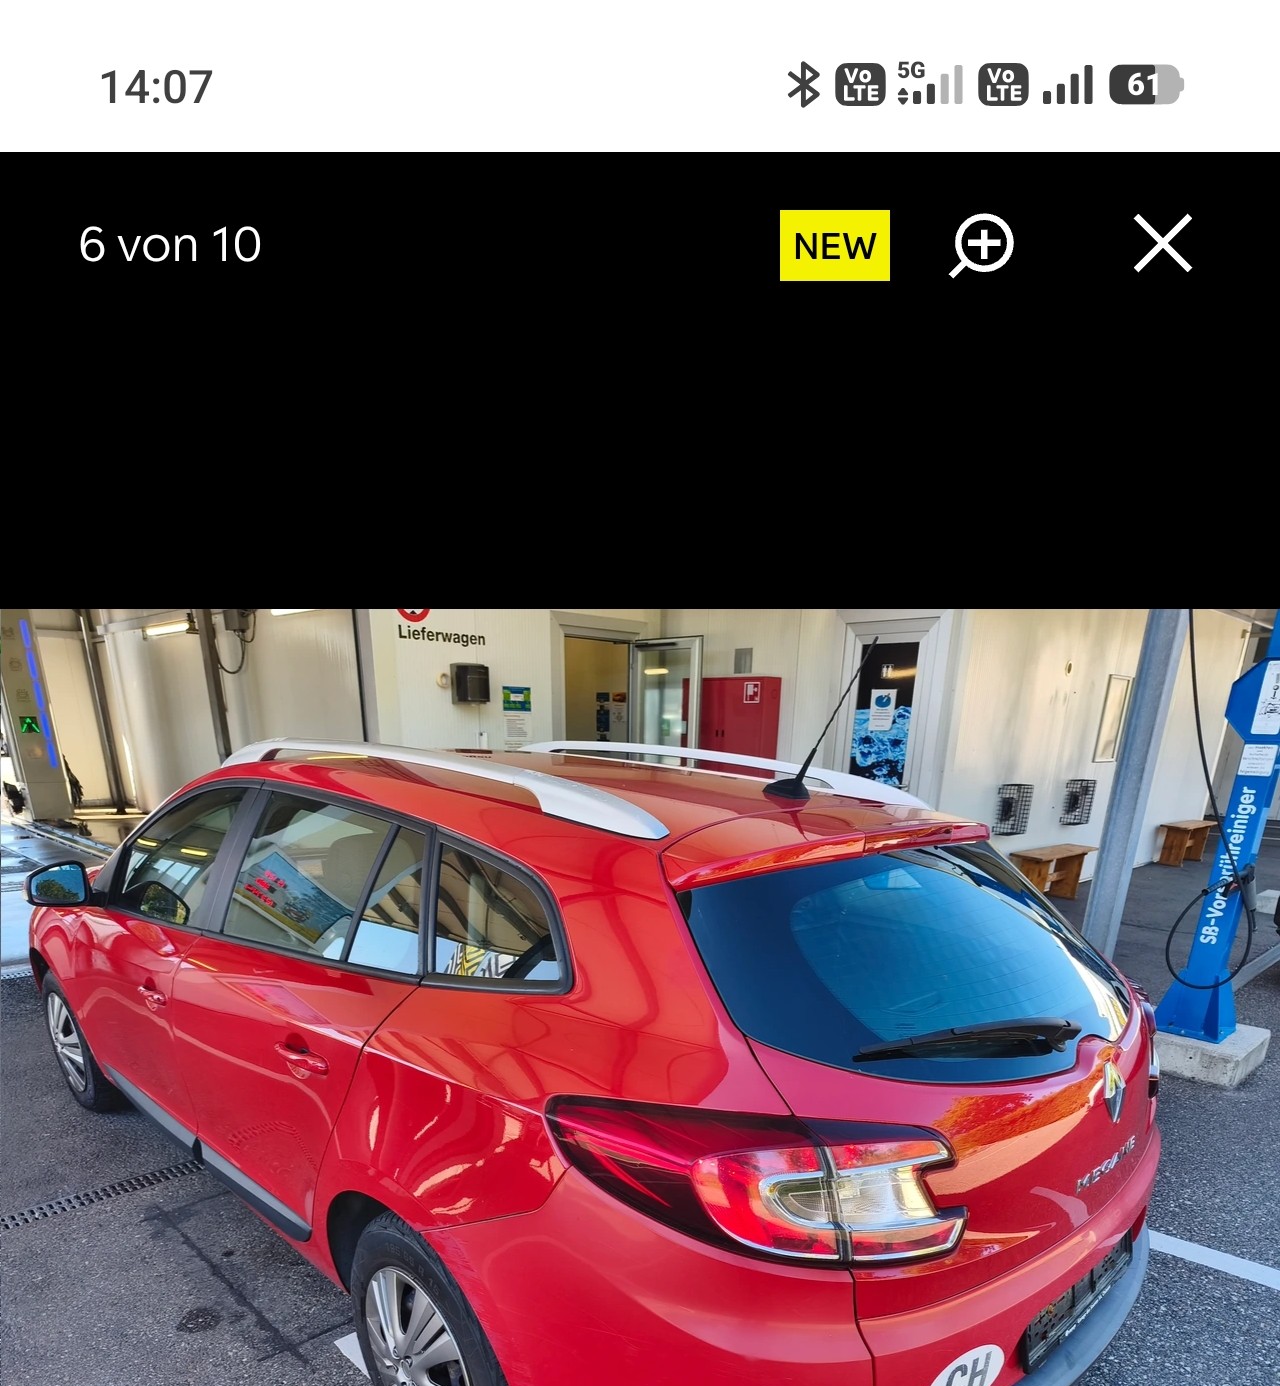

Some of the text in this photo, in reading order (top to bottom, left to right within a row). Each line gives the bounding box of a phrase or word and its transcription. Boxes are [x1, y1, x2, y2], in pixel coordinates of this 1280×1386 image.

[844, 68, 872, 83] Vo
[898, 61, 925, 79] 5G
[987, 68, 1015, 83] Vo
[101, 69, 213, 104] 14:07
[843, 85, 879, 102] LTE
[986, 85, 1022, 102] LTE
[1127, 72, 1160, 97] 61
[80, 225, 261, 263] 6 von 10
[794, 232, 877, 260] NEW
[398, 624, 486, 648] Lieferwagen
